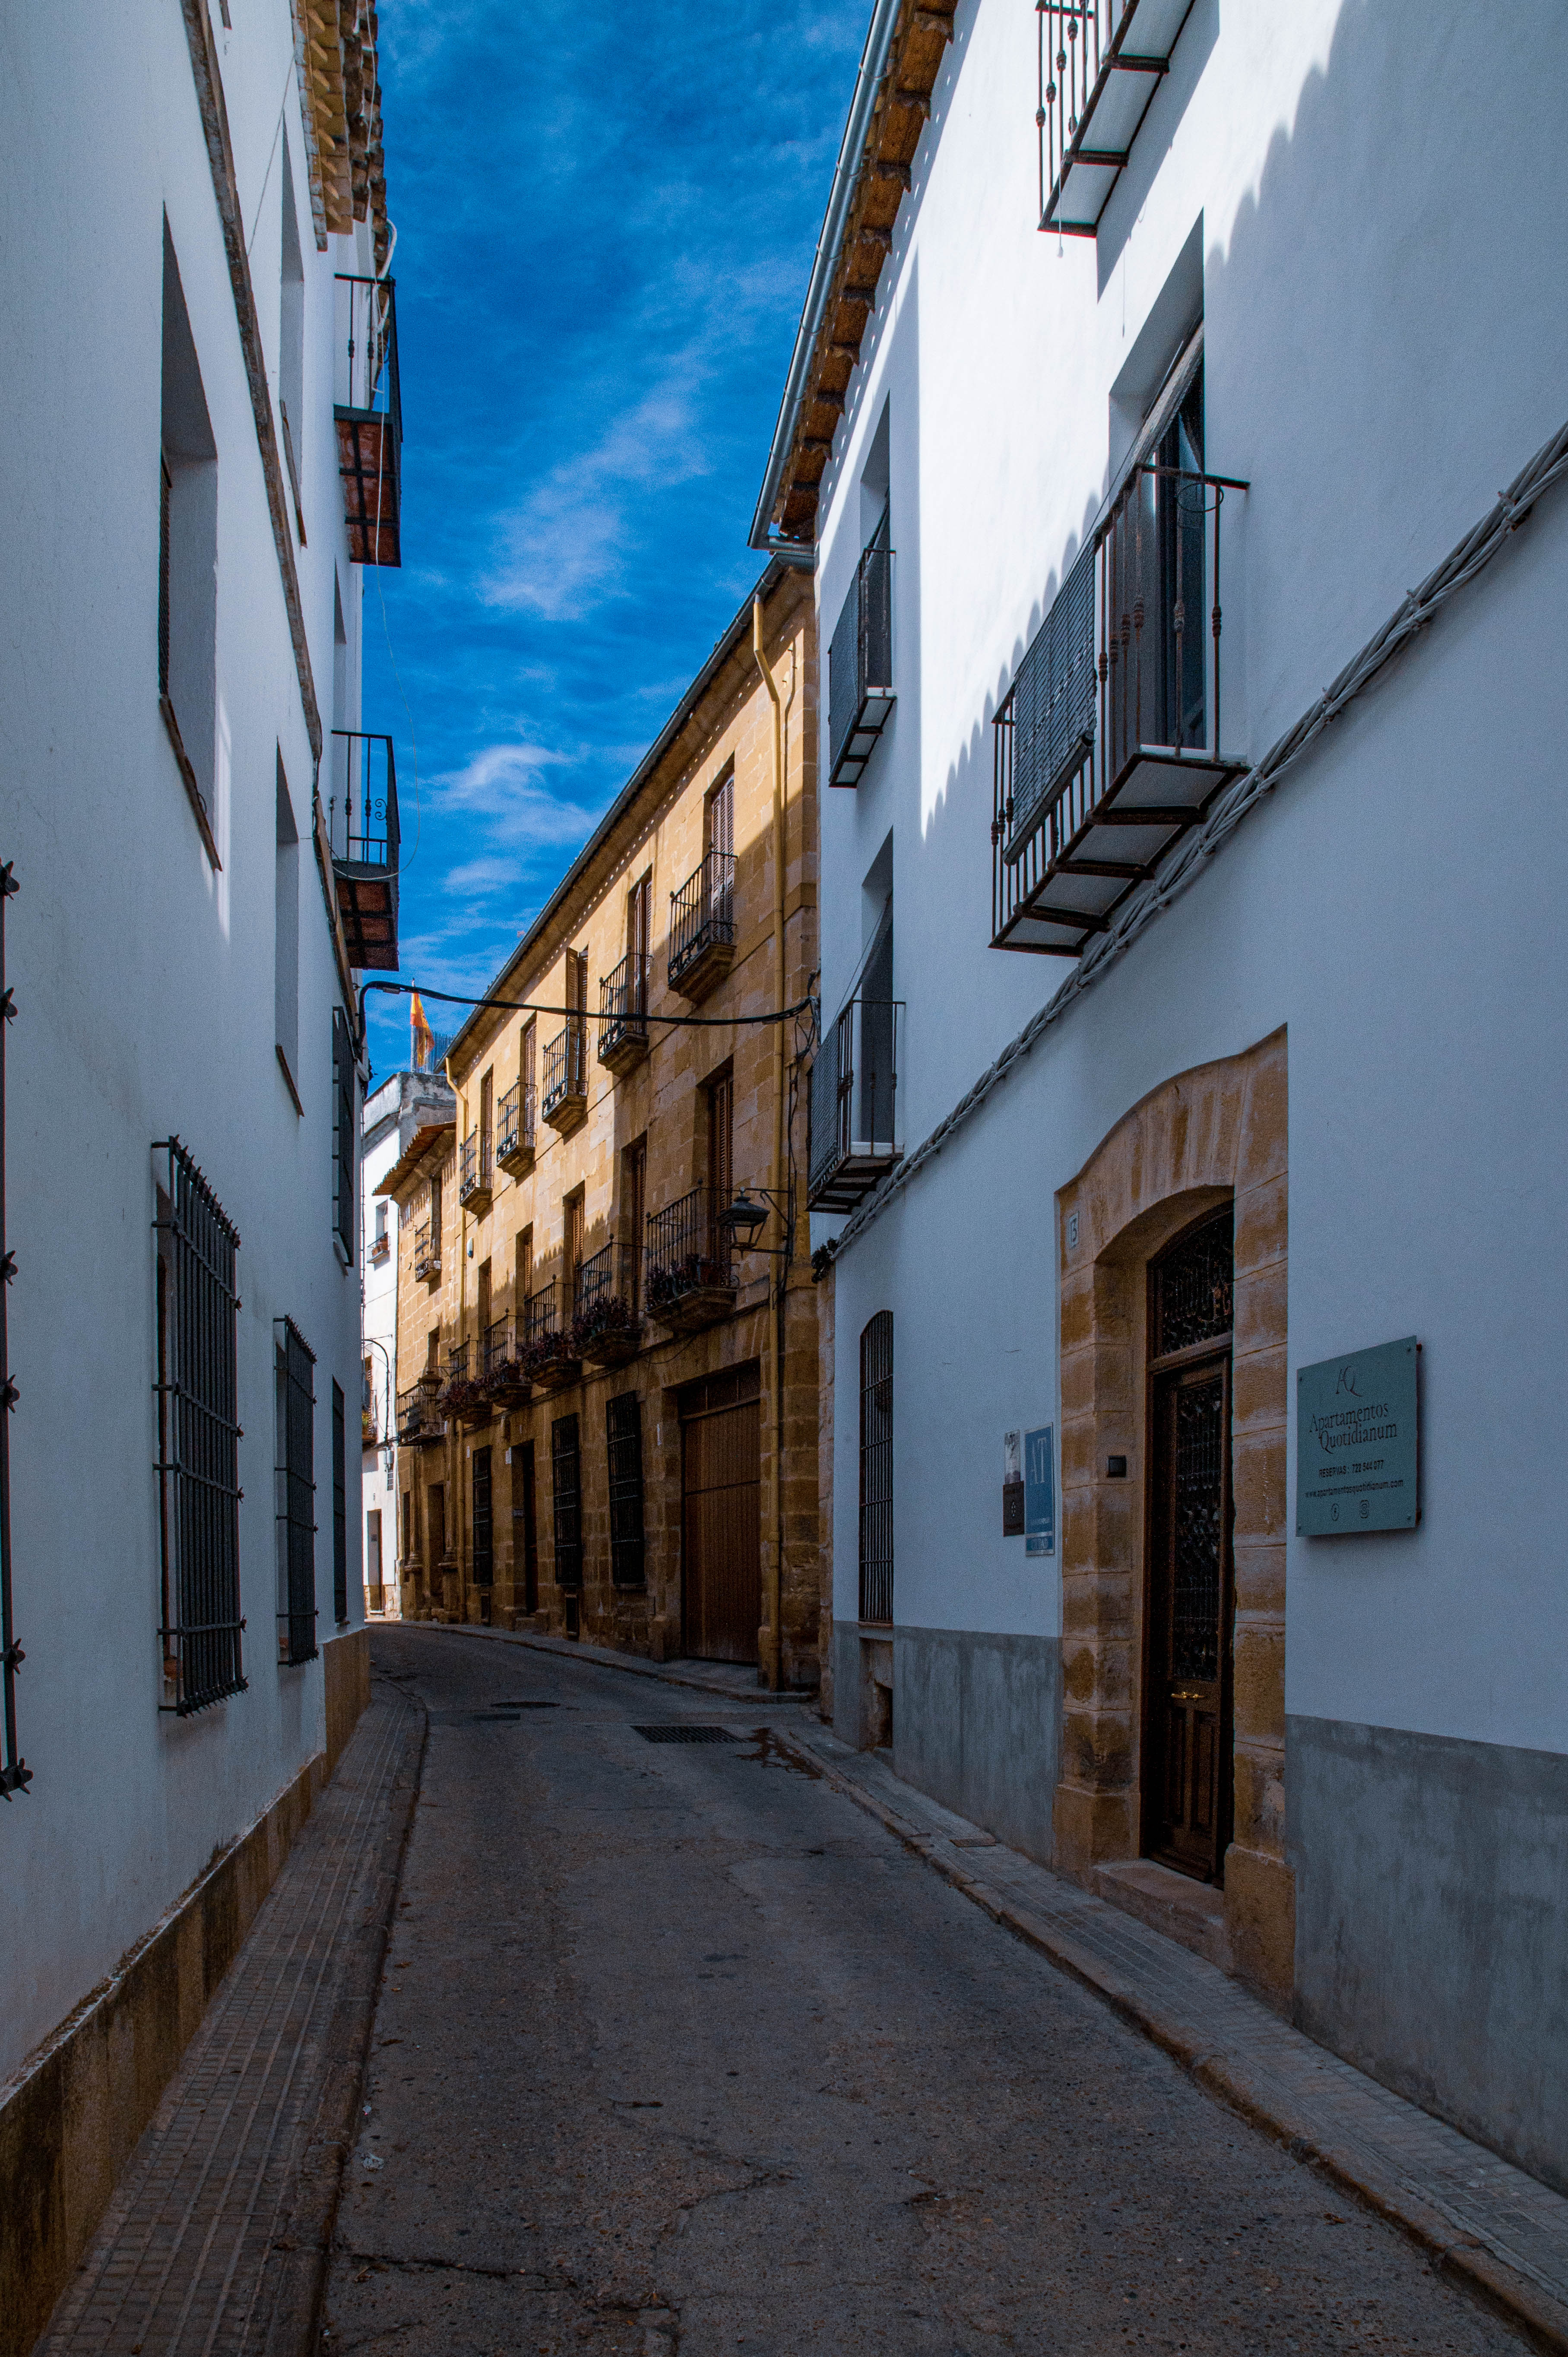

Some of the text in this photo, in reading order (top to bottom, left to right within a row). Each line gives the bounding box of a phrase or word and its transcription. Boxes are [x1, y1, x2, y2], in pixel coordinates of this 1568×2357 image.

[1309, 1403, 1389, 1438] Apartamentos
[1320, 1422, 1397, 1454] Quotidianum
[1030, 1437, 1047, 1486] AT
[1352, 1463, 1362, 1473] 722
[1363, 1462, 1372, 1472] 544
[1305, 1479, 1403, 1498] www.apartamentosquotidianum.com
